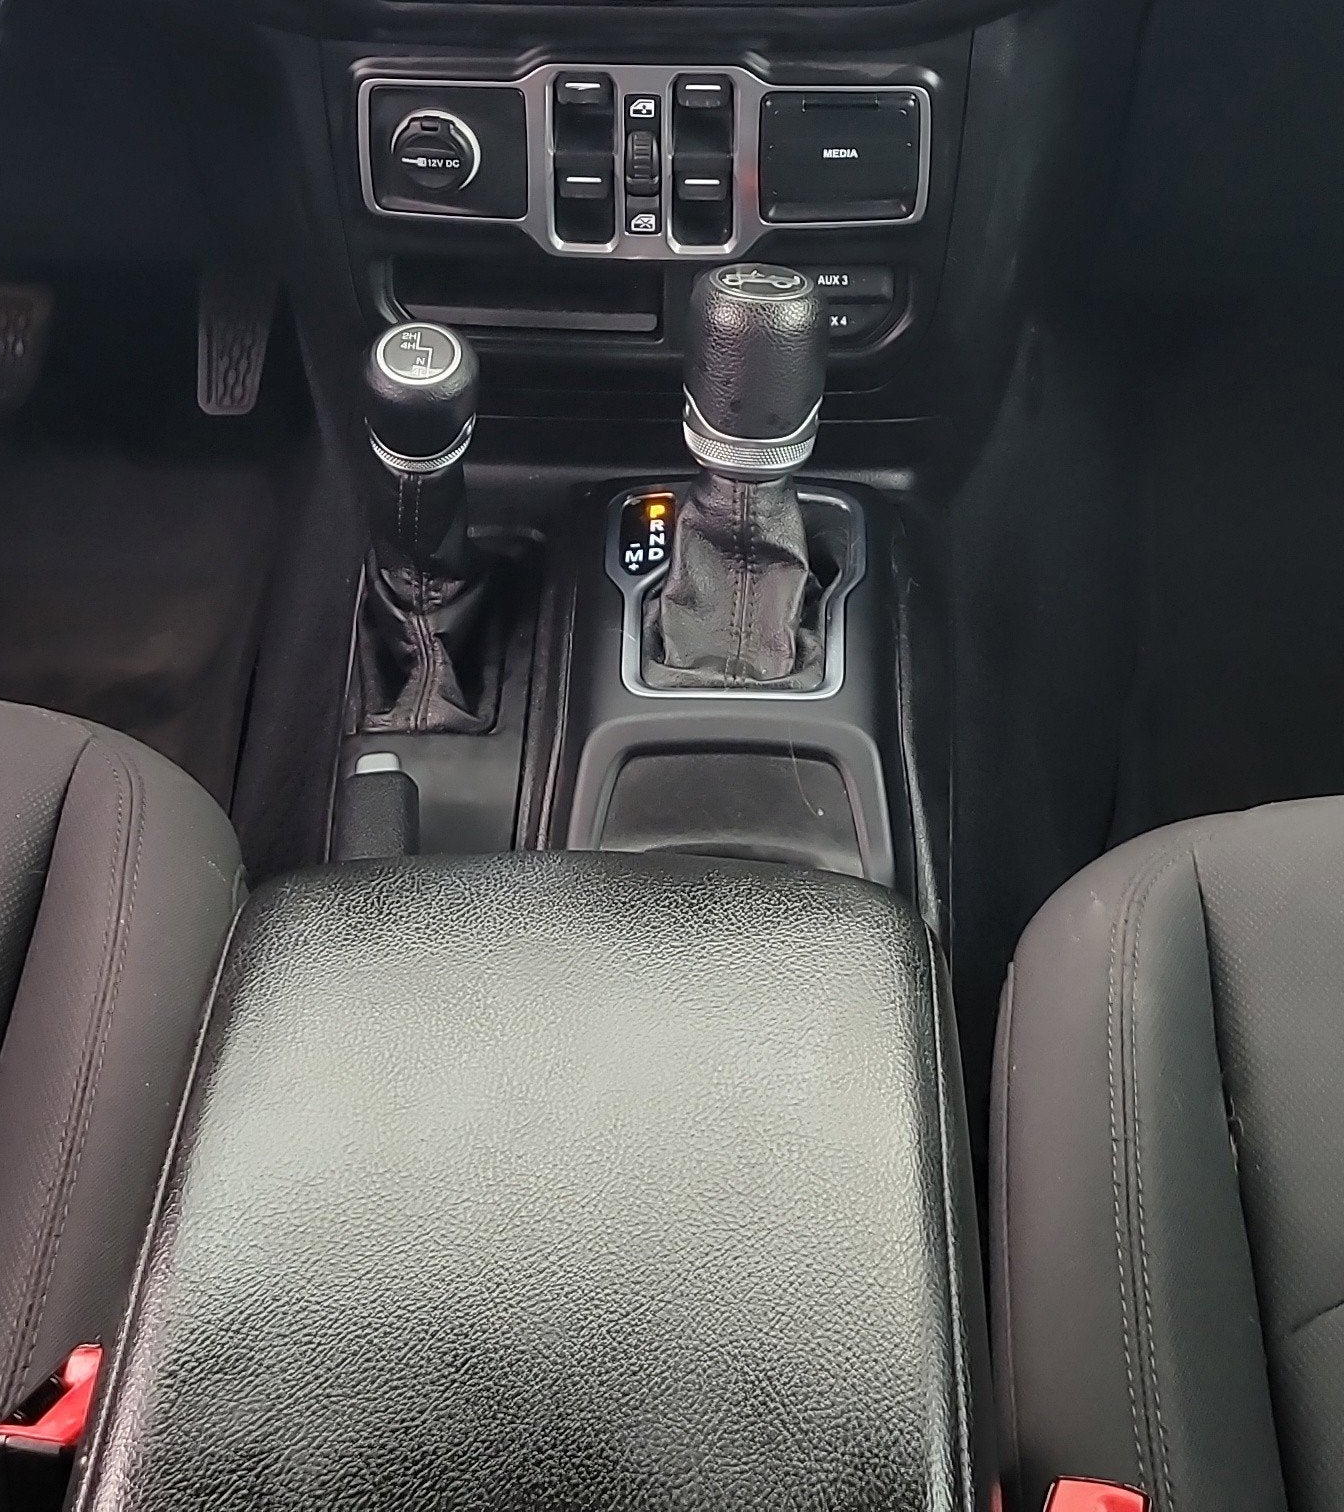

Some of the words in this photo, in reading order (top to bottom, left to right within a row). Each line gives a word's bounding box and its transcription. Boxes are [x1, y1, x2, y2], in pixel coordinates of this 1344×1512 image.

[823, 149, 859, 158] MEDIA
[428, 159, 444, 168] 12V
[445, 159, 460, 168] DC
[817, 274, 840, 285] AUX
[841, 274, 848, 285] 3
[840, 315, 847, 326] 4
[401, 332, 416, 340] 2H
[400, 341, 415, 350] 4H
[416, 357, 425, 365] N
[650, 504, 665, 518] P
[650, 519, 664, 532] R
[649, 533, 665, 546] N
[625, 549, 644, 563] M
[648, 547, 664, 560] D
